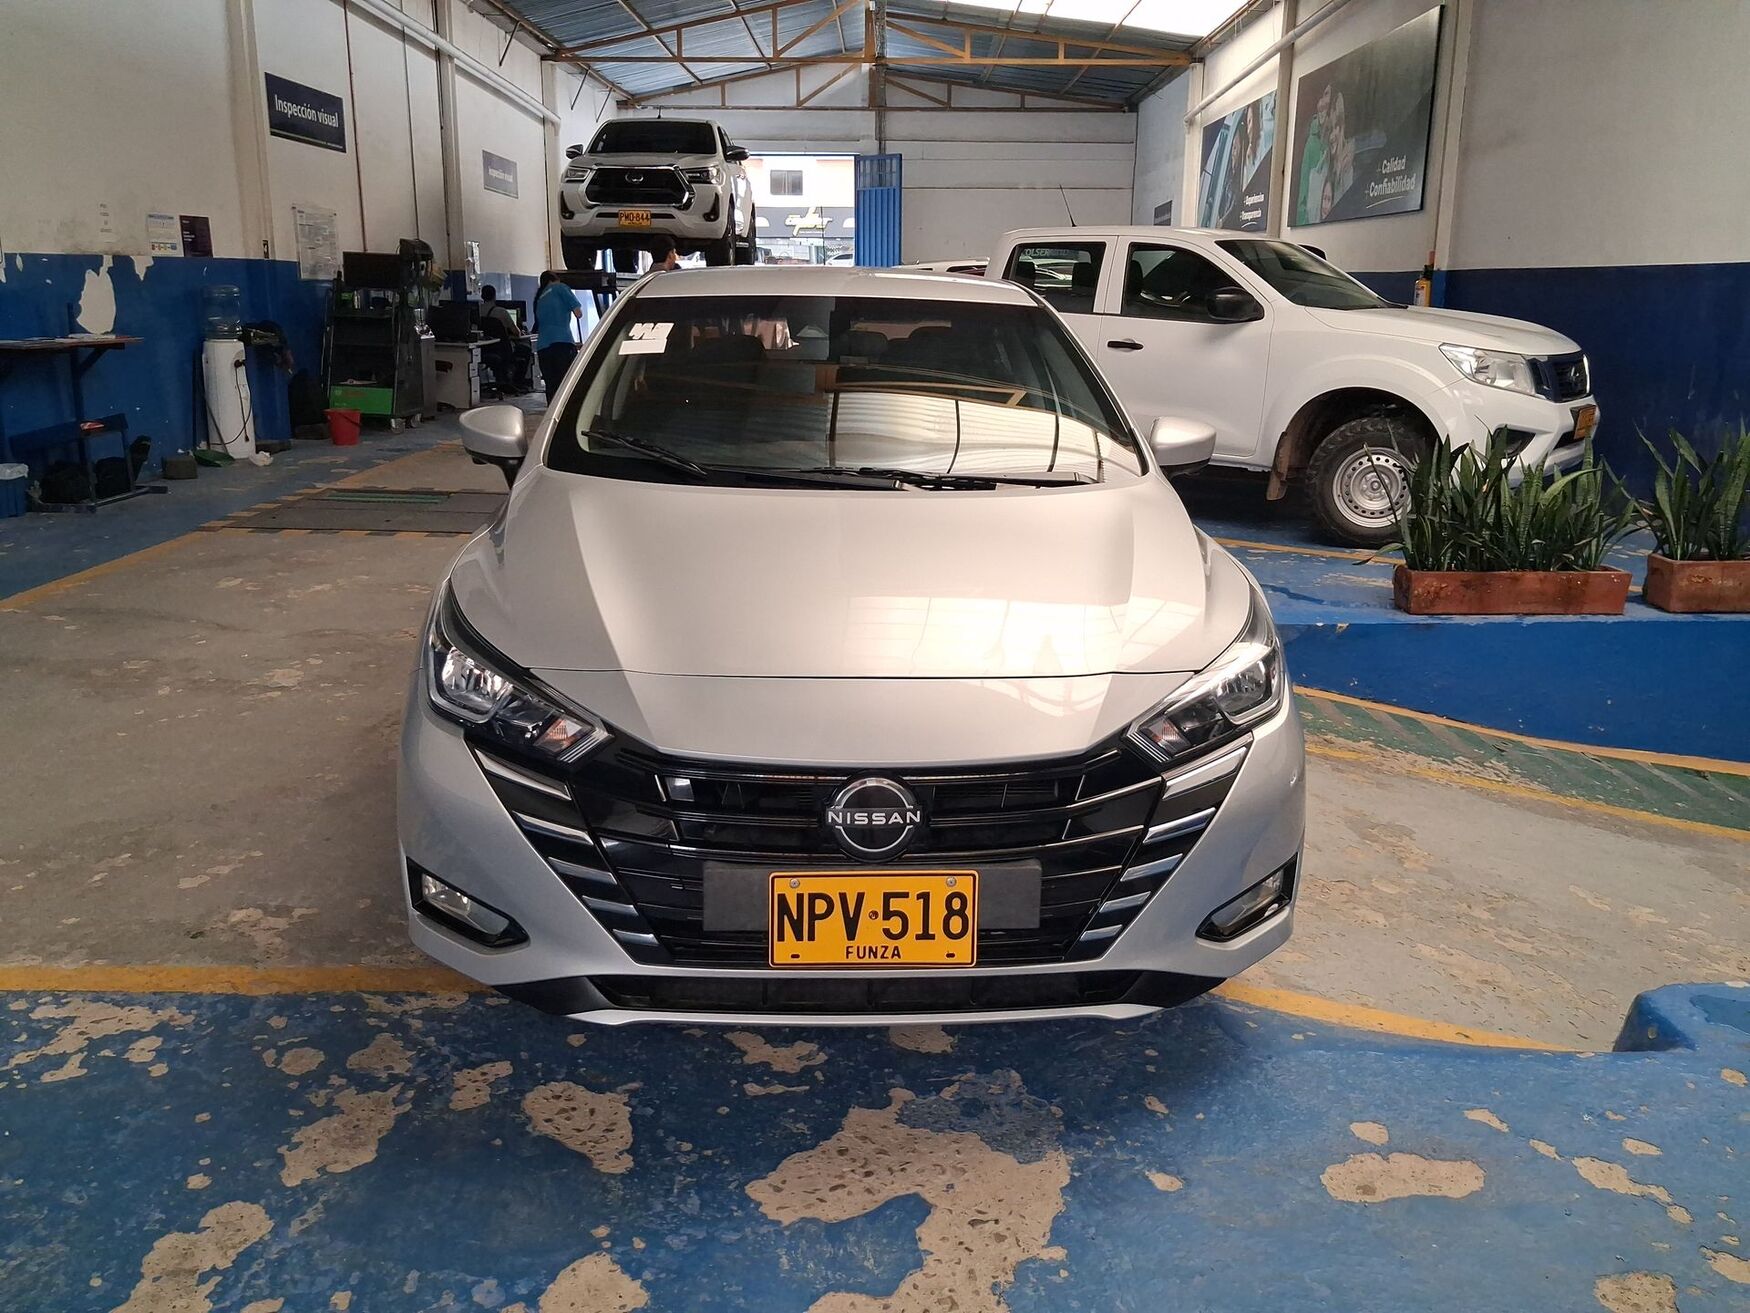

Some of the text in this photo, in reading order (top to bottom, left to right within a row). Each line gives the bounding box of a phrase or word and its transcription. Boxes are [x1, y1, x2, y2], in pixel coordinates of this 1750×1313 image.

[274, 94, 339, 128] Inspección visual
[1382, 155, 1407, 174] Calidad
[1369, 173, 1416, 197] Confiabilidad
[828, 810, 921, 825] NISSAN
[776, 891, 969, 942] NPV 518
[845, 945, 902, 960] FUNZA
